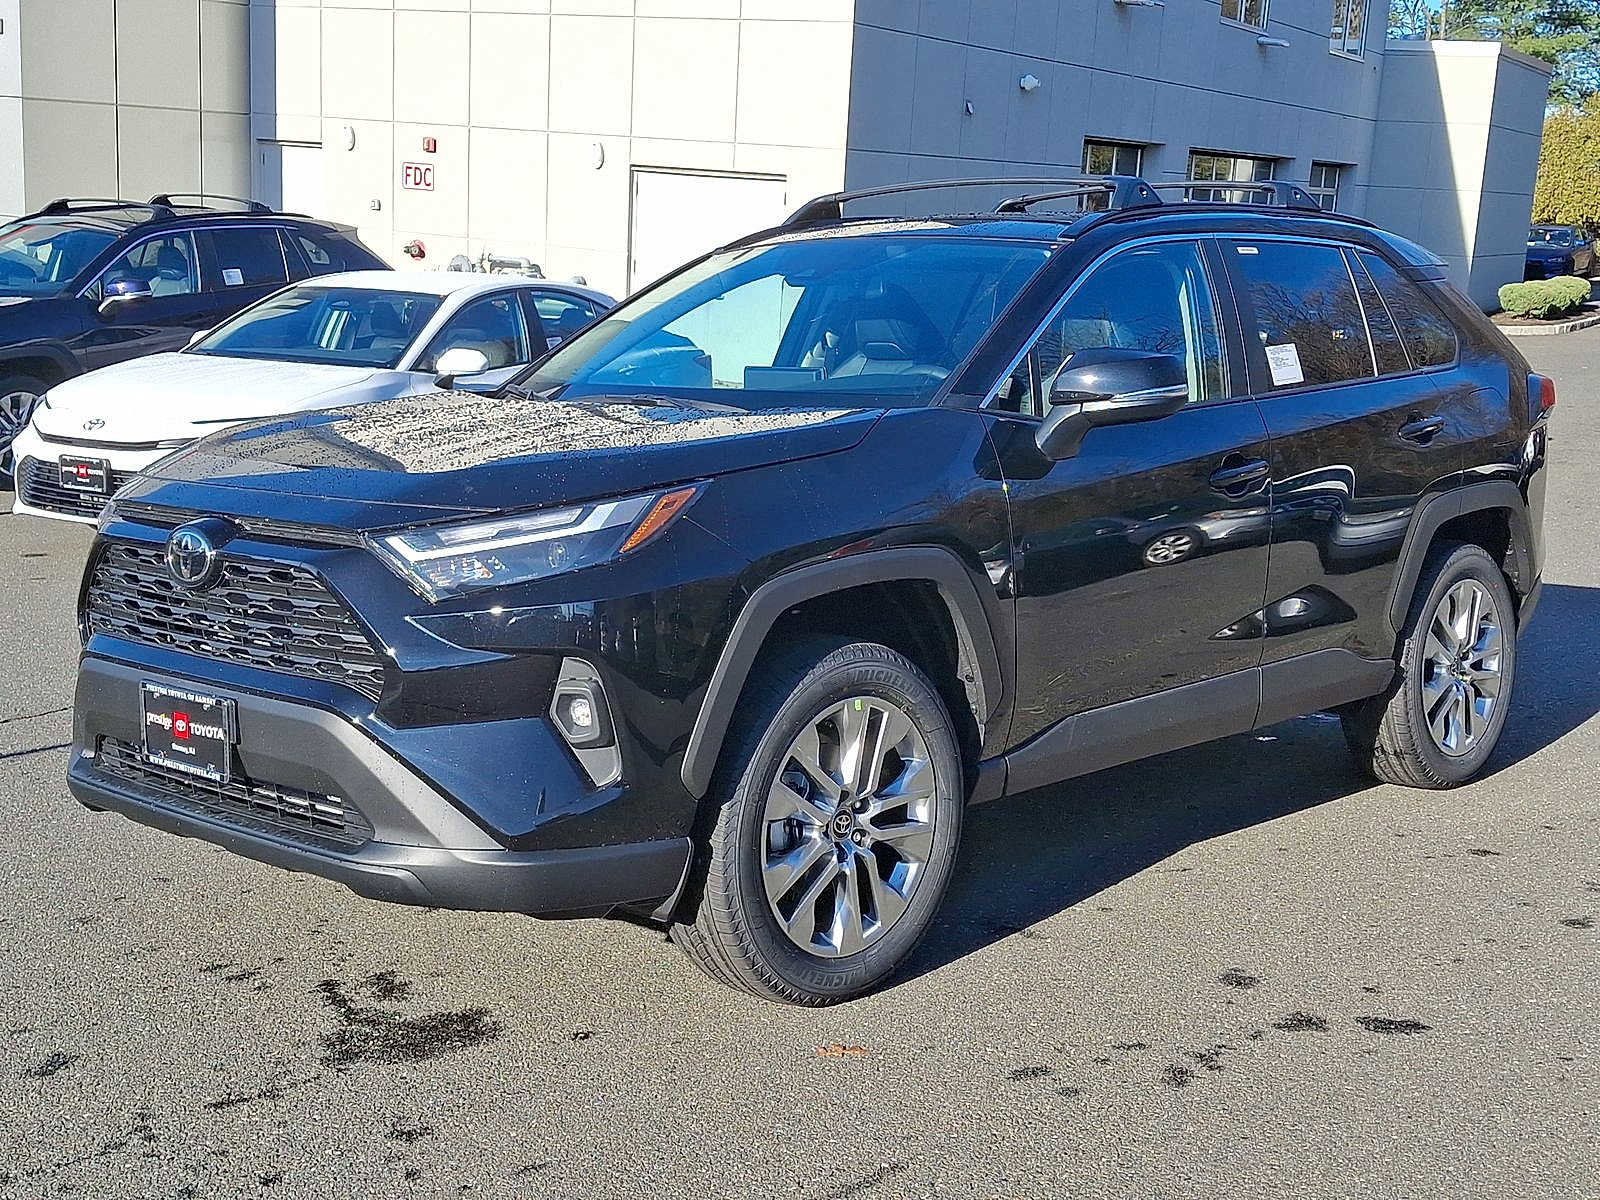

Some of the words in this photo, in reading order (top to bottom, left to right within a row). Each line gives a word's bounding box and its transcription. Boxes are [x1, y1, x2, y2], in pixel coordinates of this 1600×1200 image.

[405, 166, 432, 187] FDC
[146, 712, 173, 730] prestige
[189, 722, 225, 740] TOYOTA
